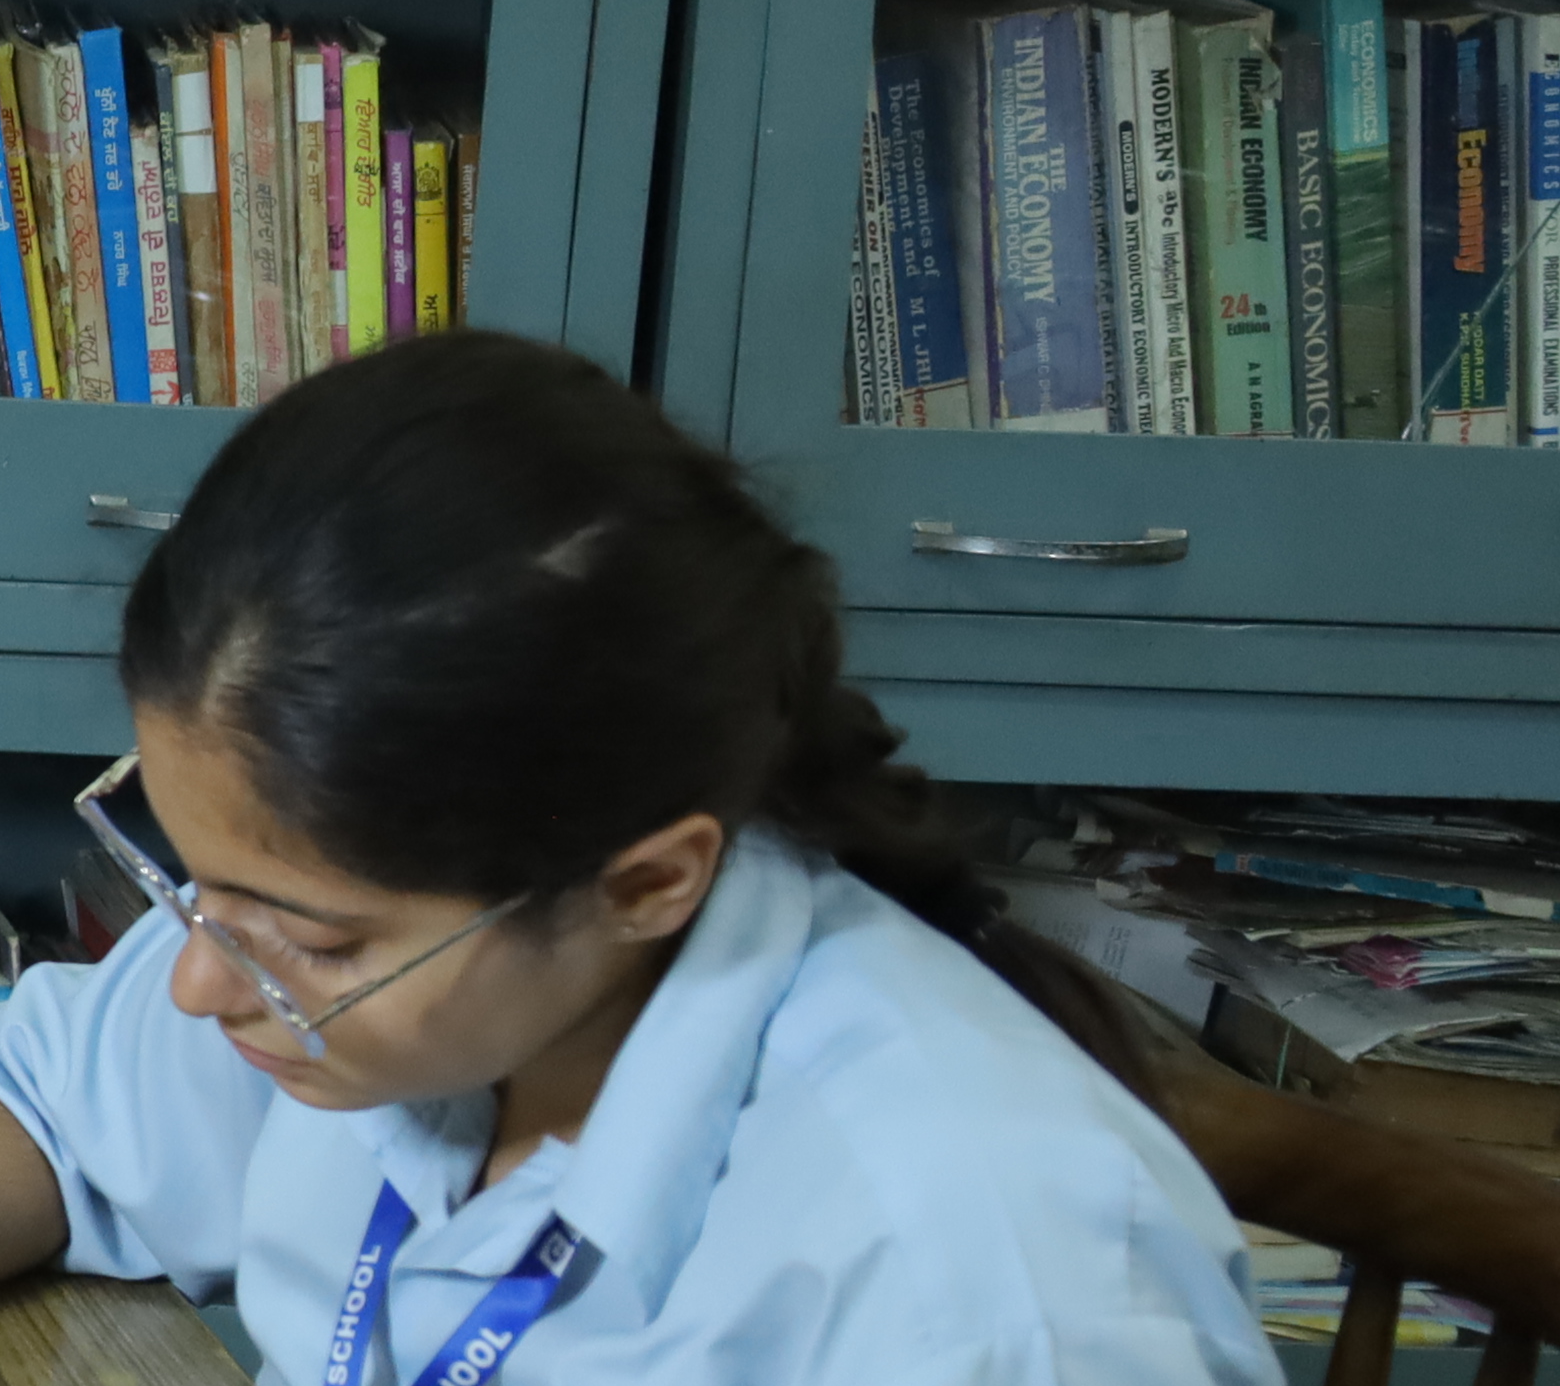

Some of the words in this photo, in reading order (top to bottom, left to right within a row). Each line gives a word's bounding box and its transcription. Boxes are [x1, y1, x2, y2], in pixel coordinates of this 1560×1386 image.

[1014, 36, 1046, 143] INDIAN
[1151, 68, 1176, 182] MODERN'S
[888, 84, 920, 230] Development
[1050, 143, 1066, 192] THE
[1122, 130, 1136, 201] MODERN'S
[1241, 138, 1268, 242] ECONOMY
[1296, 130, 1324, 231] BASIC
[1454, 129, 1486, 273] Economy
[1018, 153, 1055, 303] ECONOMY
[1125, 220, 1145, 325] INTRODUCTORY
[871, 263, 893, 421] ECONOMICS
[1132, 329, 1152, 399] ECONOMIC
[1300, 239, 1332, 440] ECONOMICS
[327, 1244, 382, 1385] SCHOOL
